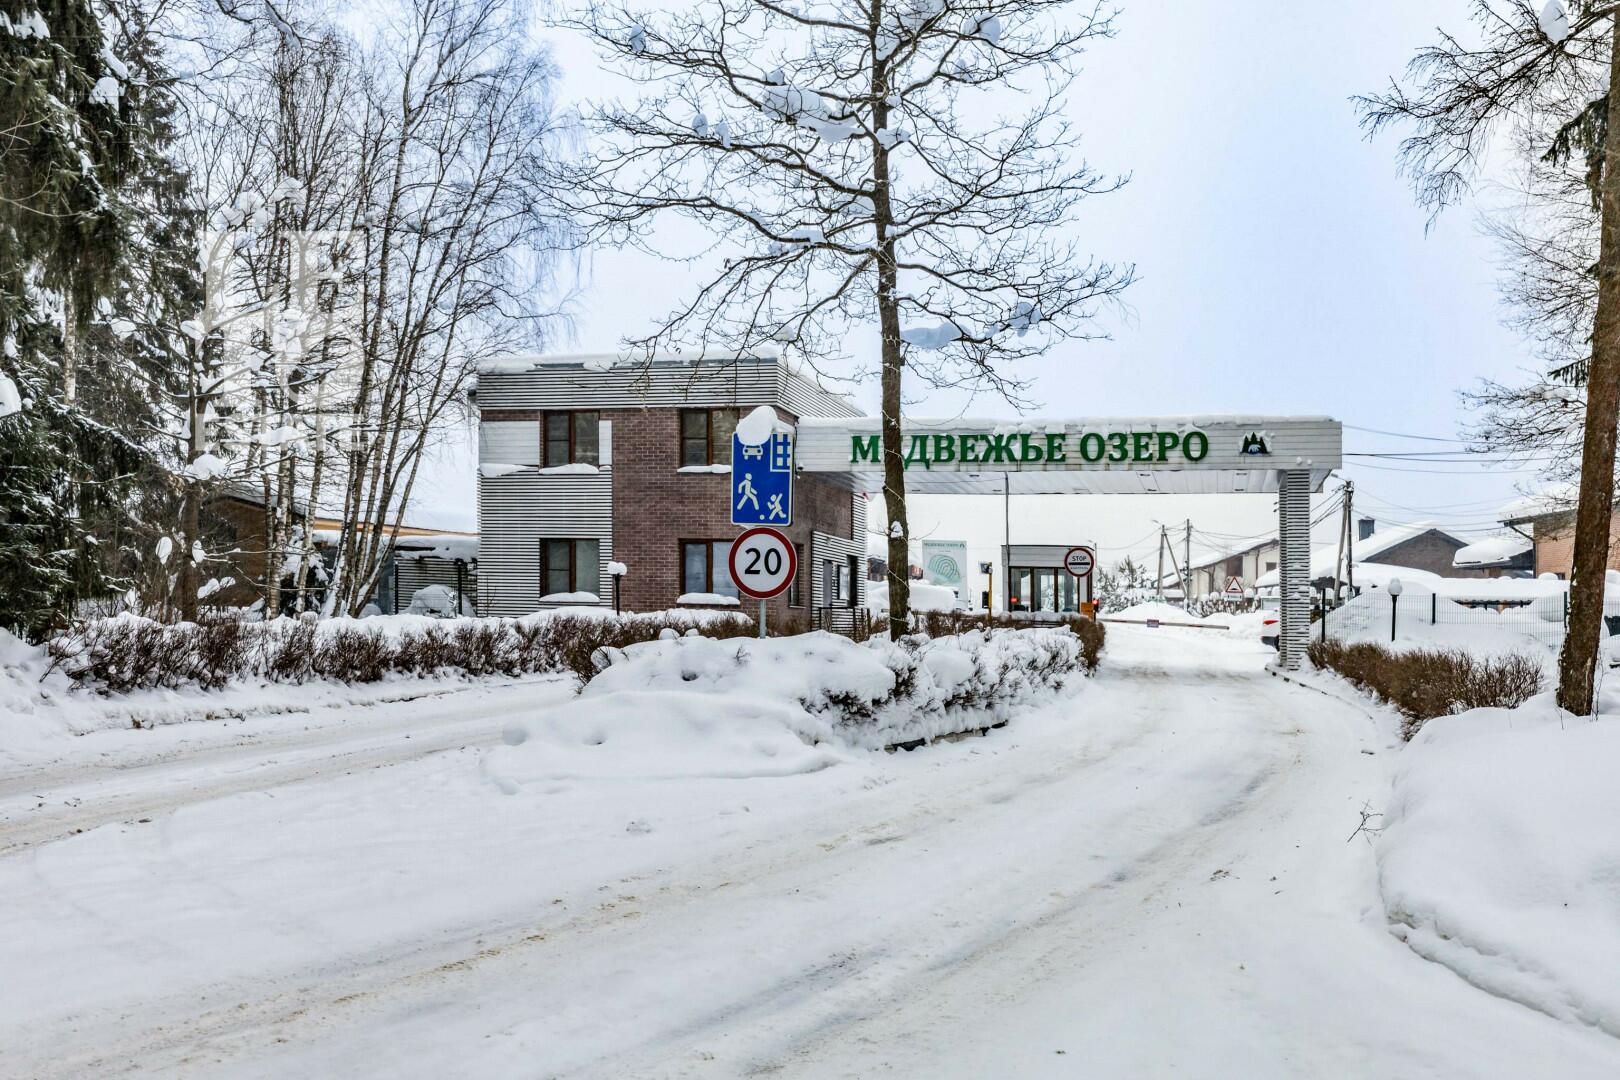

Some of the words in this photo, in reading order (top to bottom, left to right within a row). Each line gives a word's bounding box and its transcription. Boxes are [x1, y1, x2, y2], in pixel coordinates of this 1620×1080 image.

[851, 433, 1067, 470] МДВЕЖЬЕ
[1080, 431, 1209, 464] ОЗЕРО
[744, 547, 782, 576] 20
